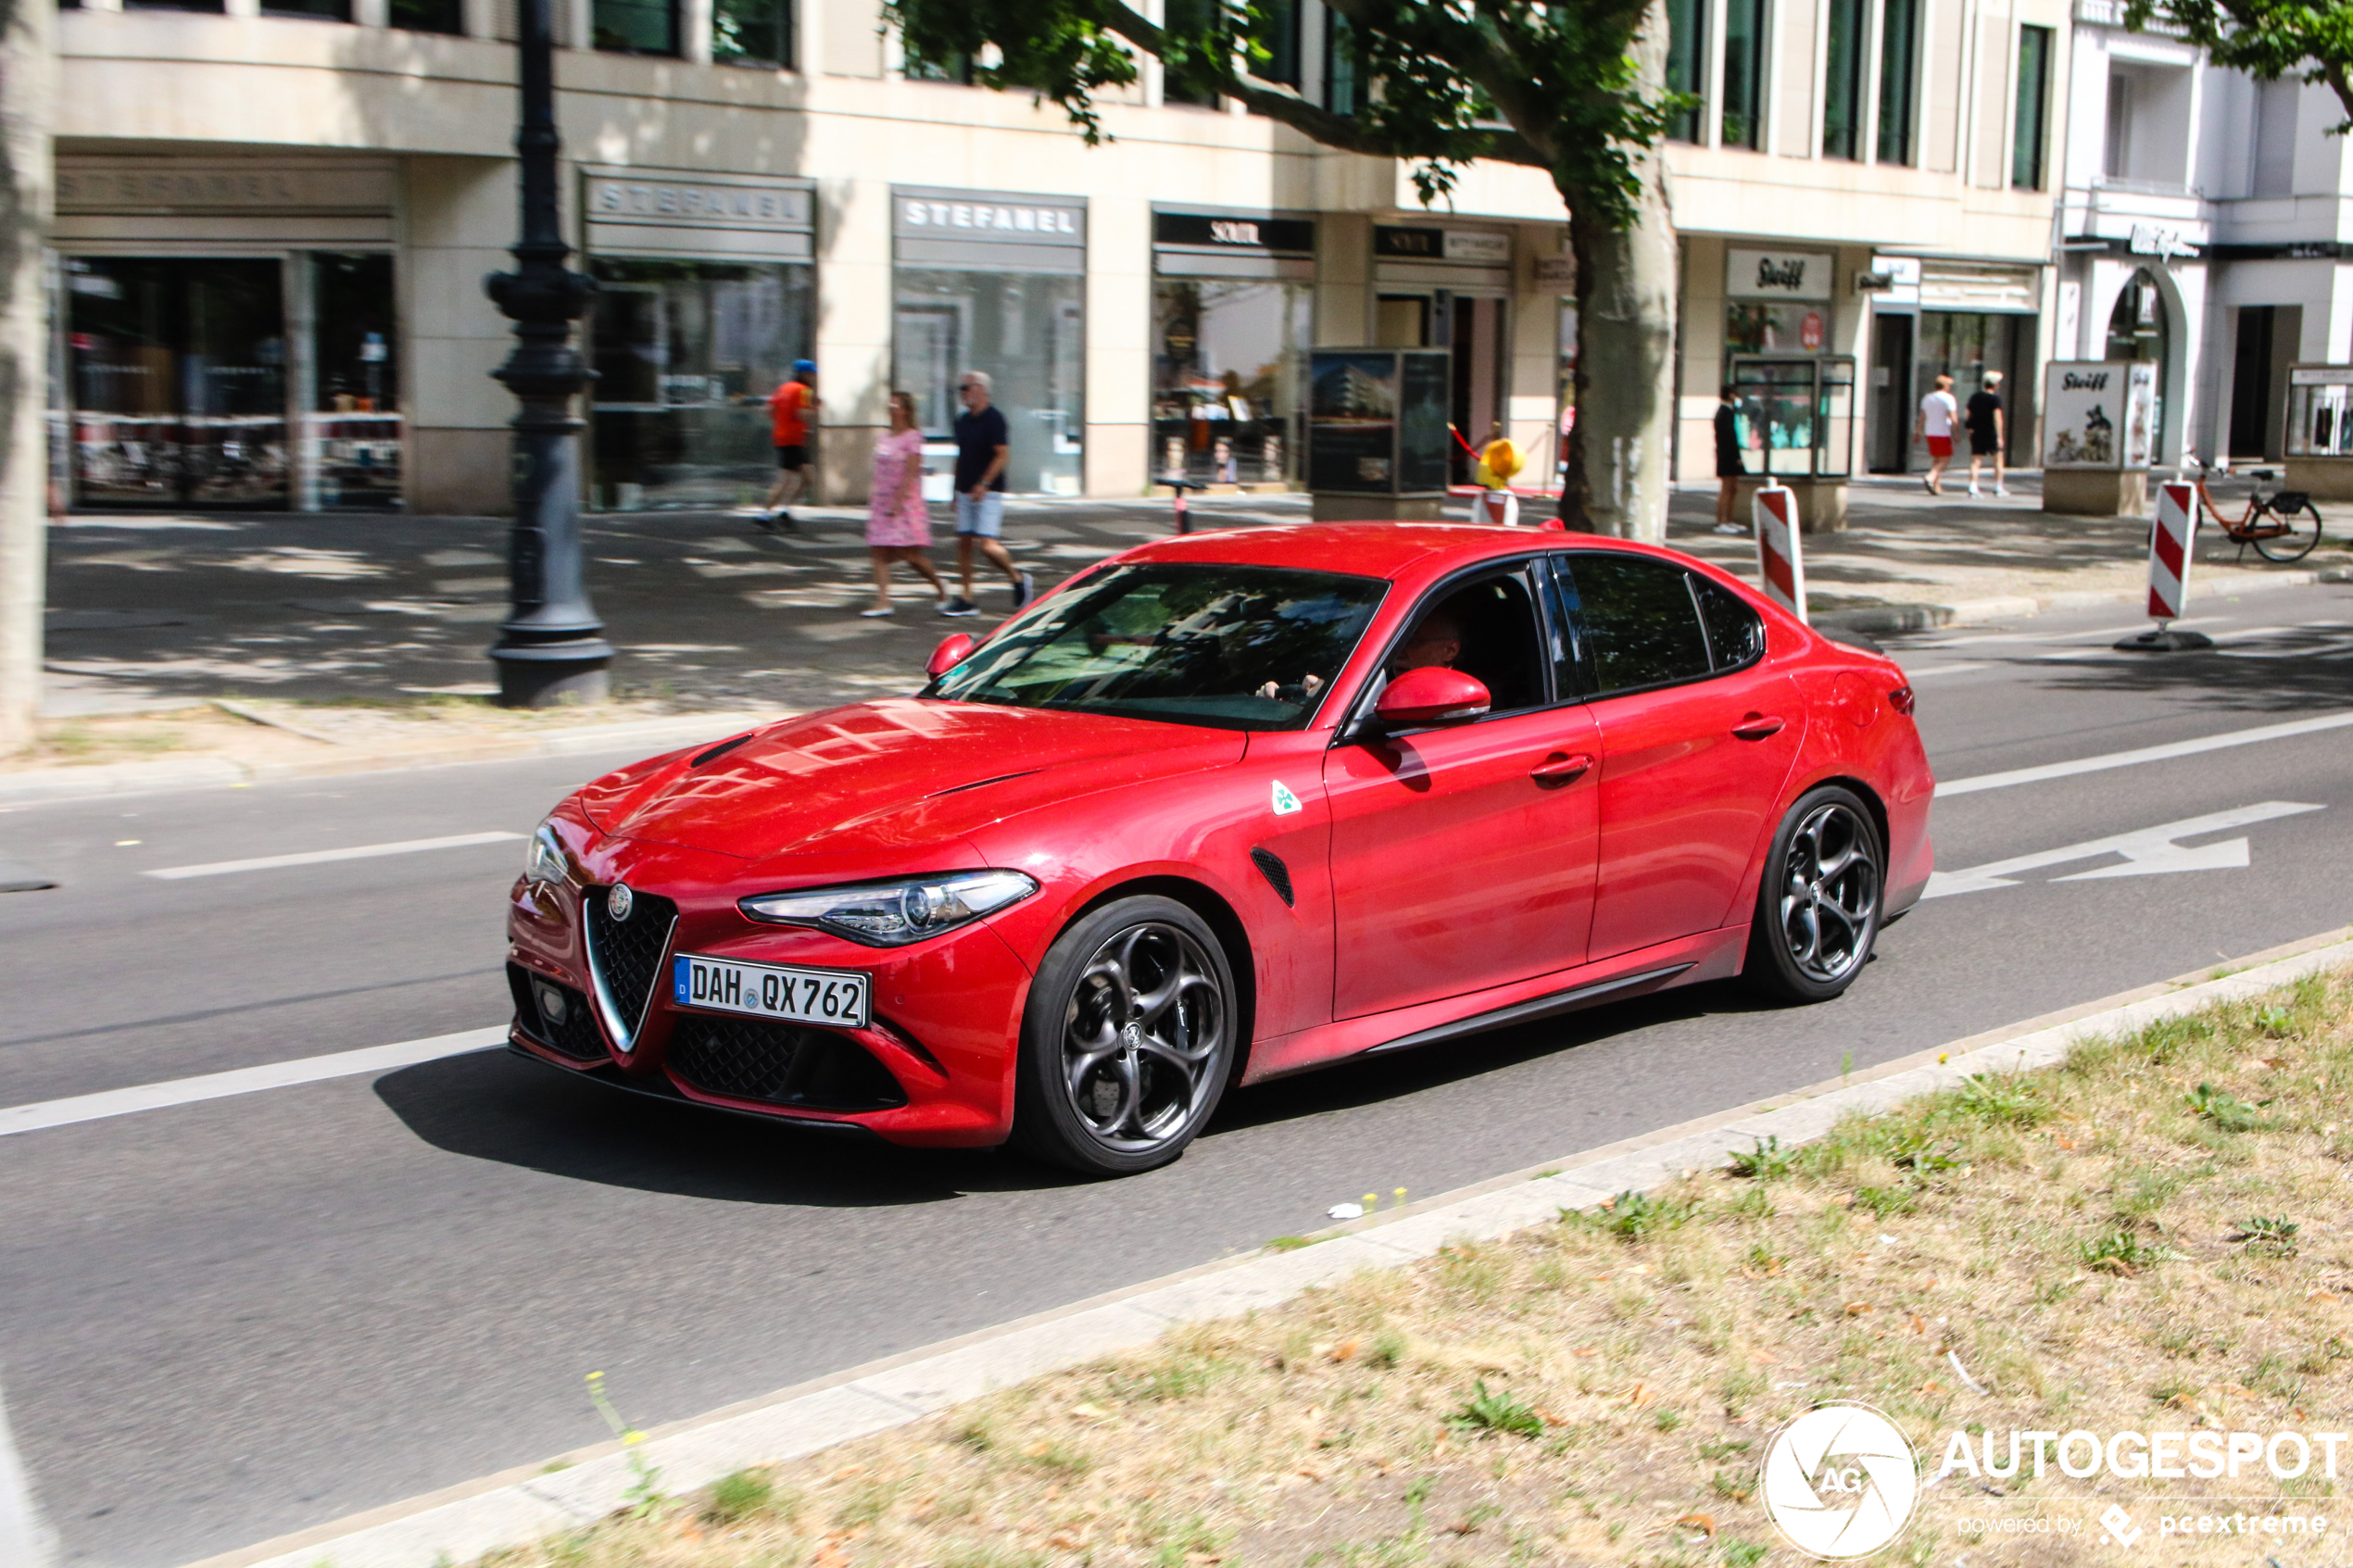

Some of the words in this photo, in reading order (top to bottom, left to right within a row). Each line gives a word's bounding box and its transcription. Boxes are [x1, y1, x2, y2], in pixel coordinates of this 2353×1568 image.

[601, 185, 796, 218] STEFANEL
[905, 201, 1075, 233] STEFANEL
[2061, 371, 2109, 391] Steiff
[679, 984, 686, 995] D
[692, 964, 741, 1006] DAH
[762, 973, 797, 1013] QX
[803, 978, 860, 1020] 762
